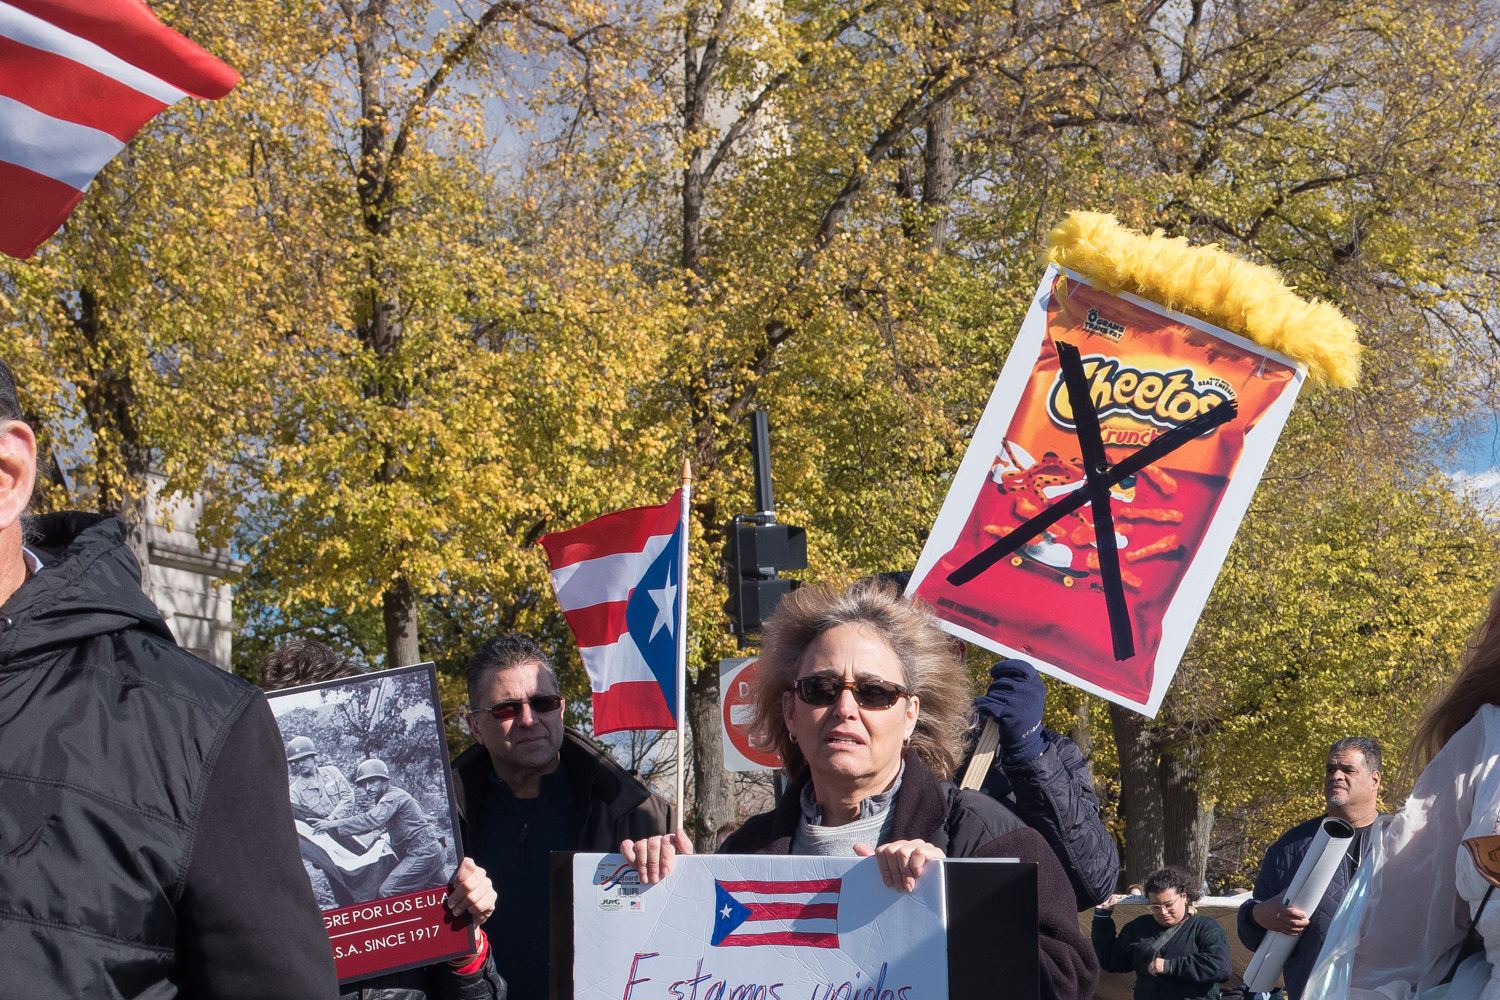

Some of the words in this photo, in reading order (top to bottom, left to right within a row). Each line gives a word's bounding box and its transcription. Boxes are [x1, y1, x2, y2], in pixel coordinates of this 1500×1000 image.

[1084, 321, 1109, 335] TRANS
[1109, 329, 1122, 339] FAT
[1097, 318, 1125, 333] GRAMS
[322, 912, 351, 930] GRE
[352, 905, 384, 923] POR
[385, 899, 413, 916] LOS
[332, 943, 362, 960] .S.A.
[364, 933, 407, 952] SINCE
[408, 924, 440, 942] 1917
